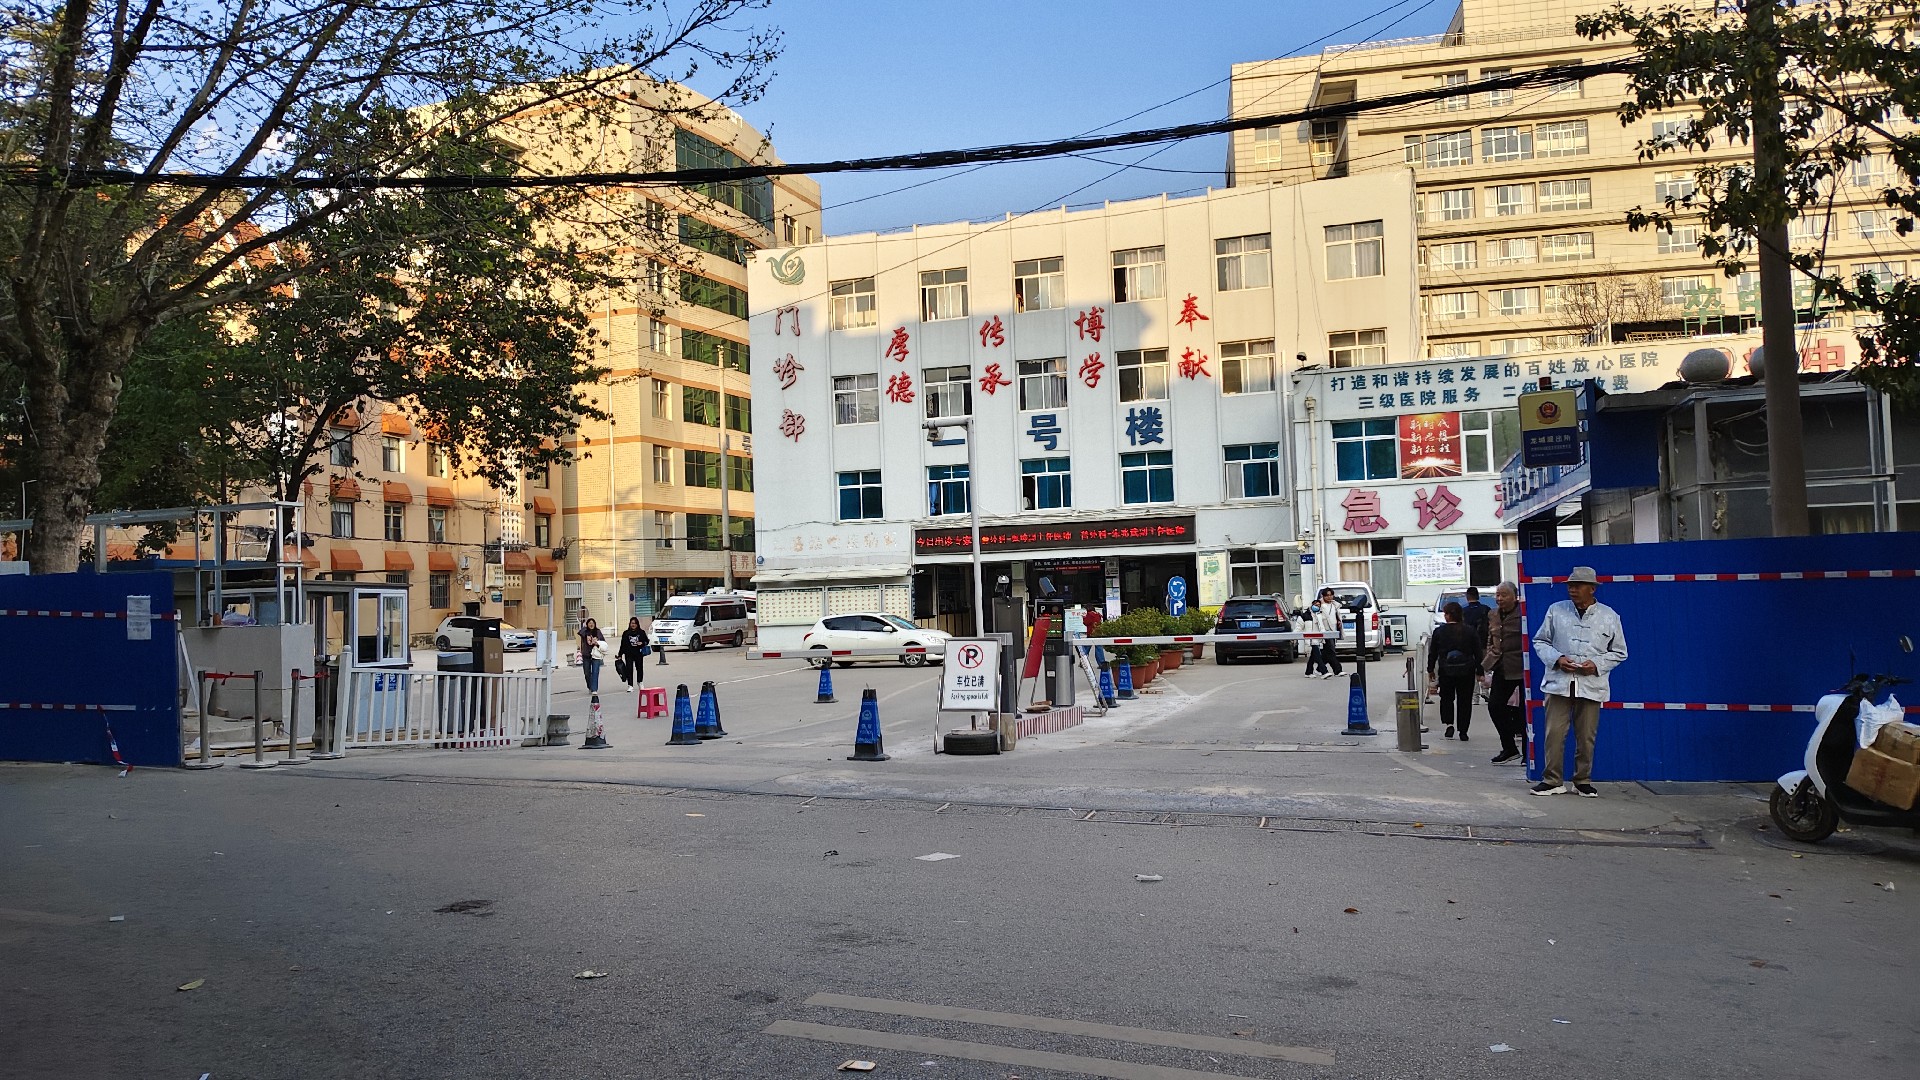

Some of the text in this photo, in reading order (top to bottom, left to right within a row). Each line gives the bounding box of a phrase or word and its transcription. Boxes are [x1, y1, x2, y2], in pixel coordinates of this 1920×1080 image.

[979, 315, 1012, 396] 传承
[1073, 306, 1106, 389] 博学
[1175, 292, 1212, 381] 奉献
[772, 305, 806, 442] 门诊部
[884, 326, 916, 404] 厚德
[1330, 351, 1660, 392] 打造和谐持续发展的百姓放心医院
[1358, 386, 1480, 411] 三级医院服务
[932, 406, 1165, 451] 一号楼
[1409, 418, 1450, 431] 新时代
[1341, 485, 1506, 534] 急诊
[956, 674, 985, 688] 车位已满
